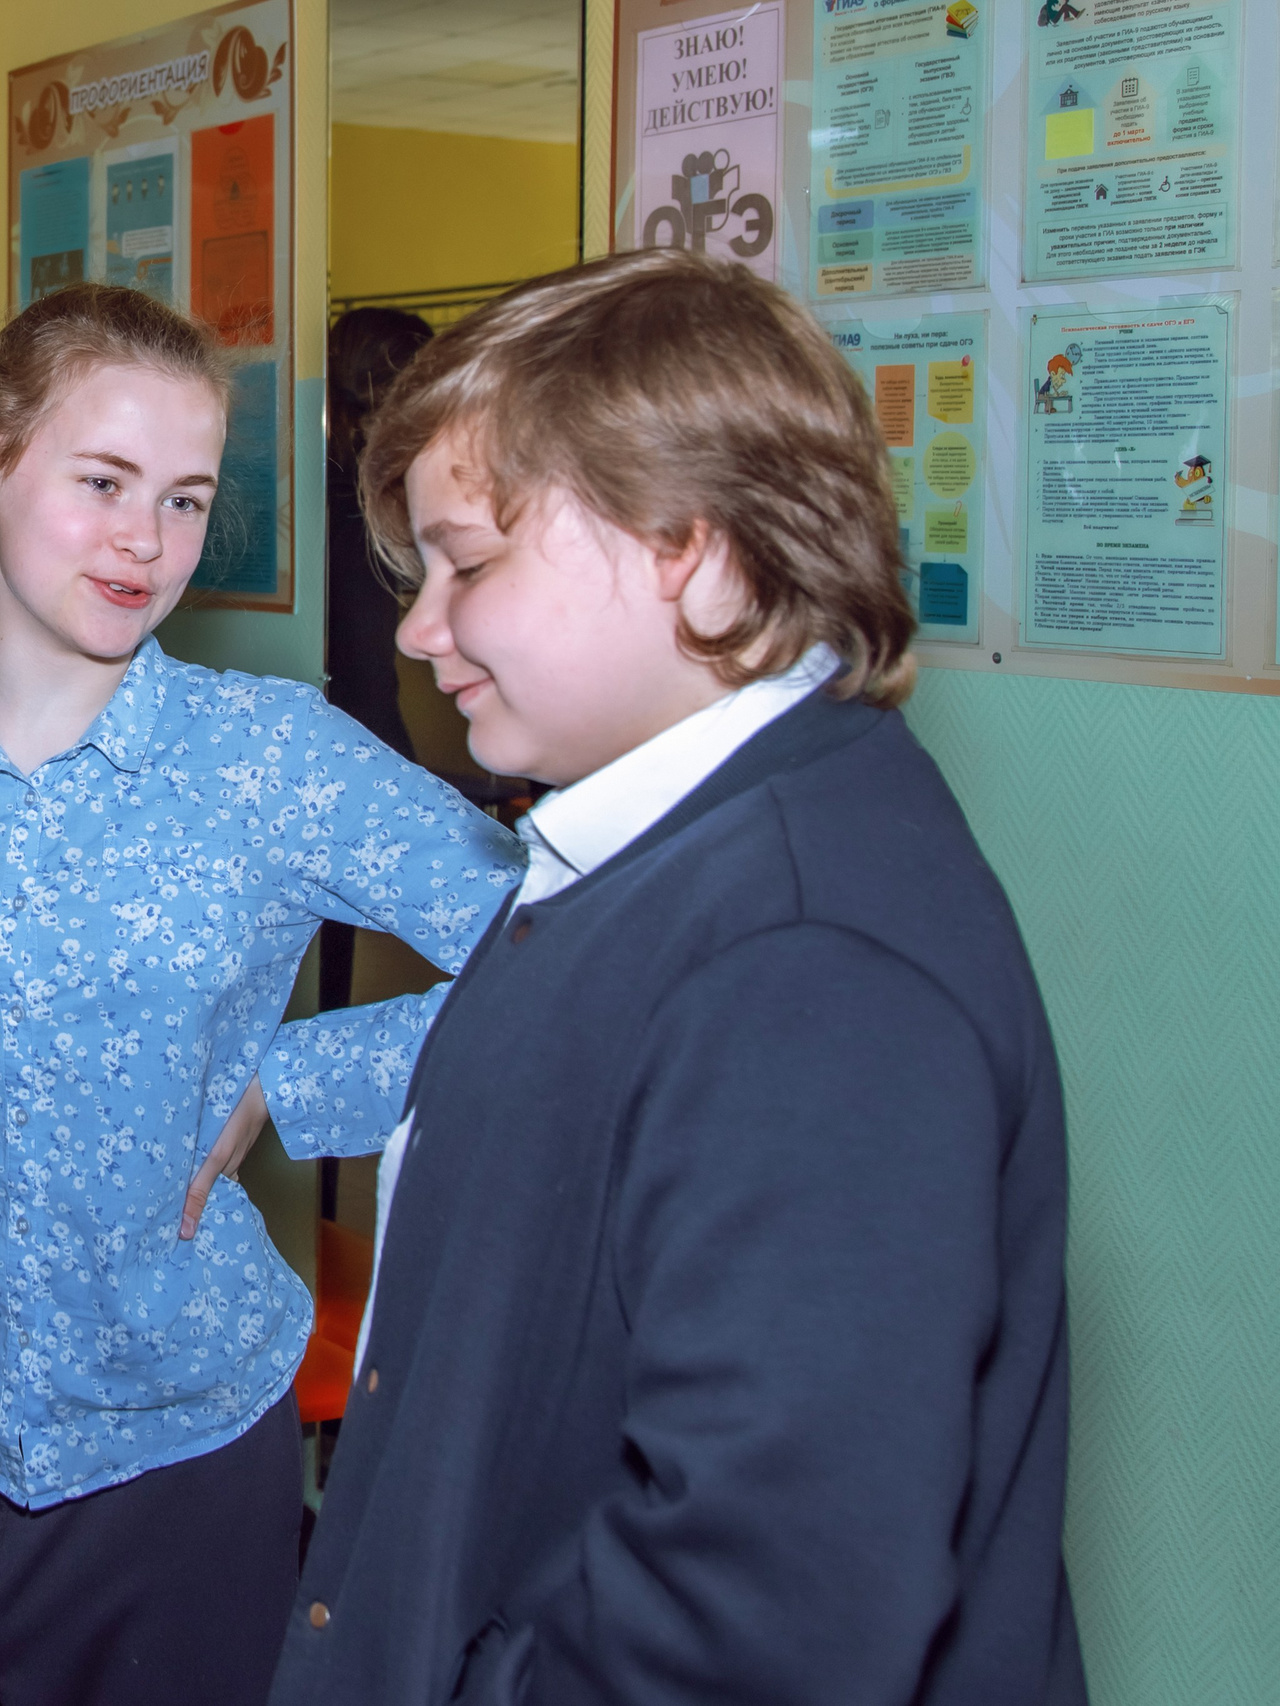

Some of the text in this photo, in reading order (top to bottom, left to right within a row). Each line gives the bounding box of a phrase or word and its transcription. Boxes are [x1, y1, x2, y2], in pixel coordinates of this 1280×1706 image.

[674, 26, 744, 60] ЗНАЮ!
[71, 52, 208, 113] ПРОФОРИЕНТАЦИЯ
[672, 58, 747, 93] УМЕЮ!
[644, 87, 773, 133] ДЕЙСТВУЮ!
[1107, 136, 1151, 146] включительно
[643, 193, 774, 258] ОГЭ
[926, 341, 938, 349] при
